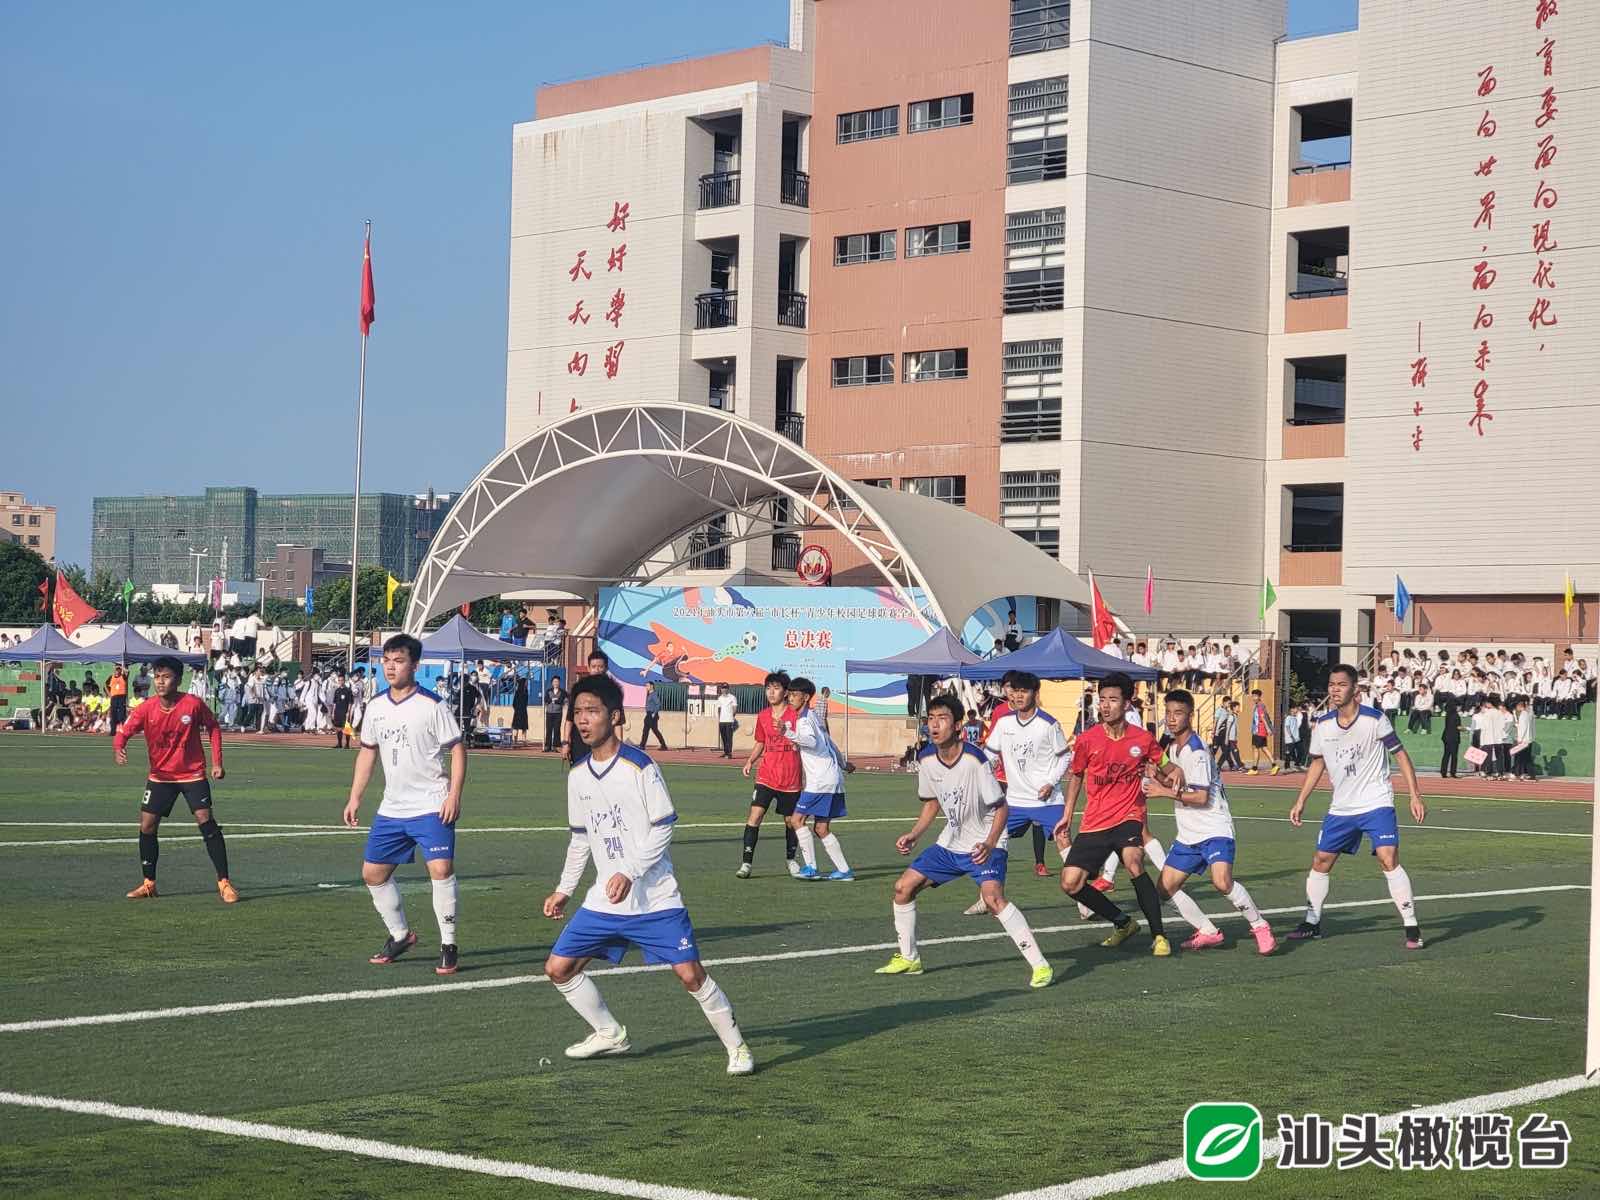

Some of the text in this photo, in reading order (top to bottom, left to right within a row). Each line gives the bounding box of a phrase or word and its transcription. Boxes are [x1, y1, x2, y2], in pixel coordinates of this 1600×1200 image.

[784, 630, 833, 649] 总决赛
[603, 836, 624, 860] 24
